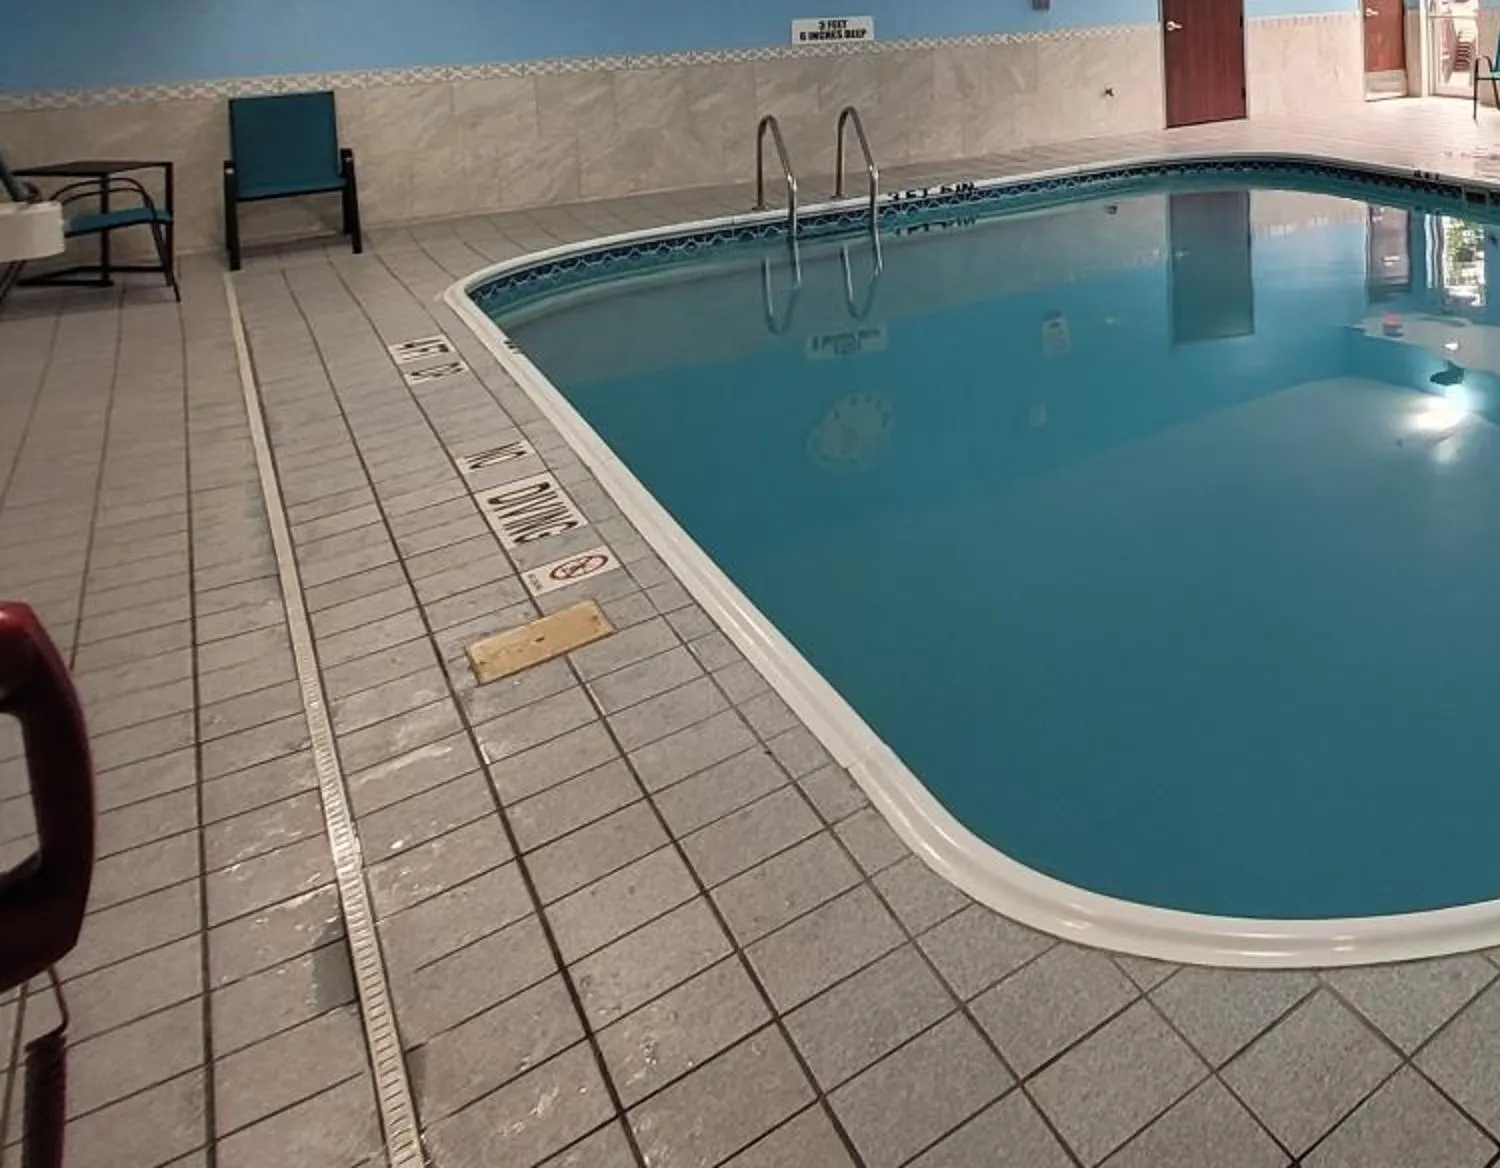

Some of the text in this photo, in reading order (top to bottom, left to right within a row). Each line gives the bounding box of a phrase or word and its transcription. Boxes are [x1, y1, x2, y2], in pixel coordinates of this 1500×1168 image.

[828, 19, 848, 29] FEET
[843, 28, 867, 39] DEEP
[487, 481, 579, 544] DIVING
